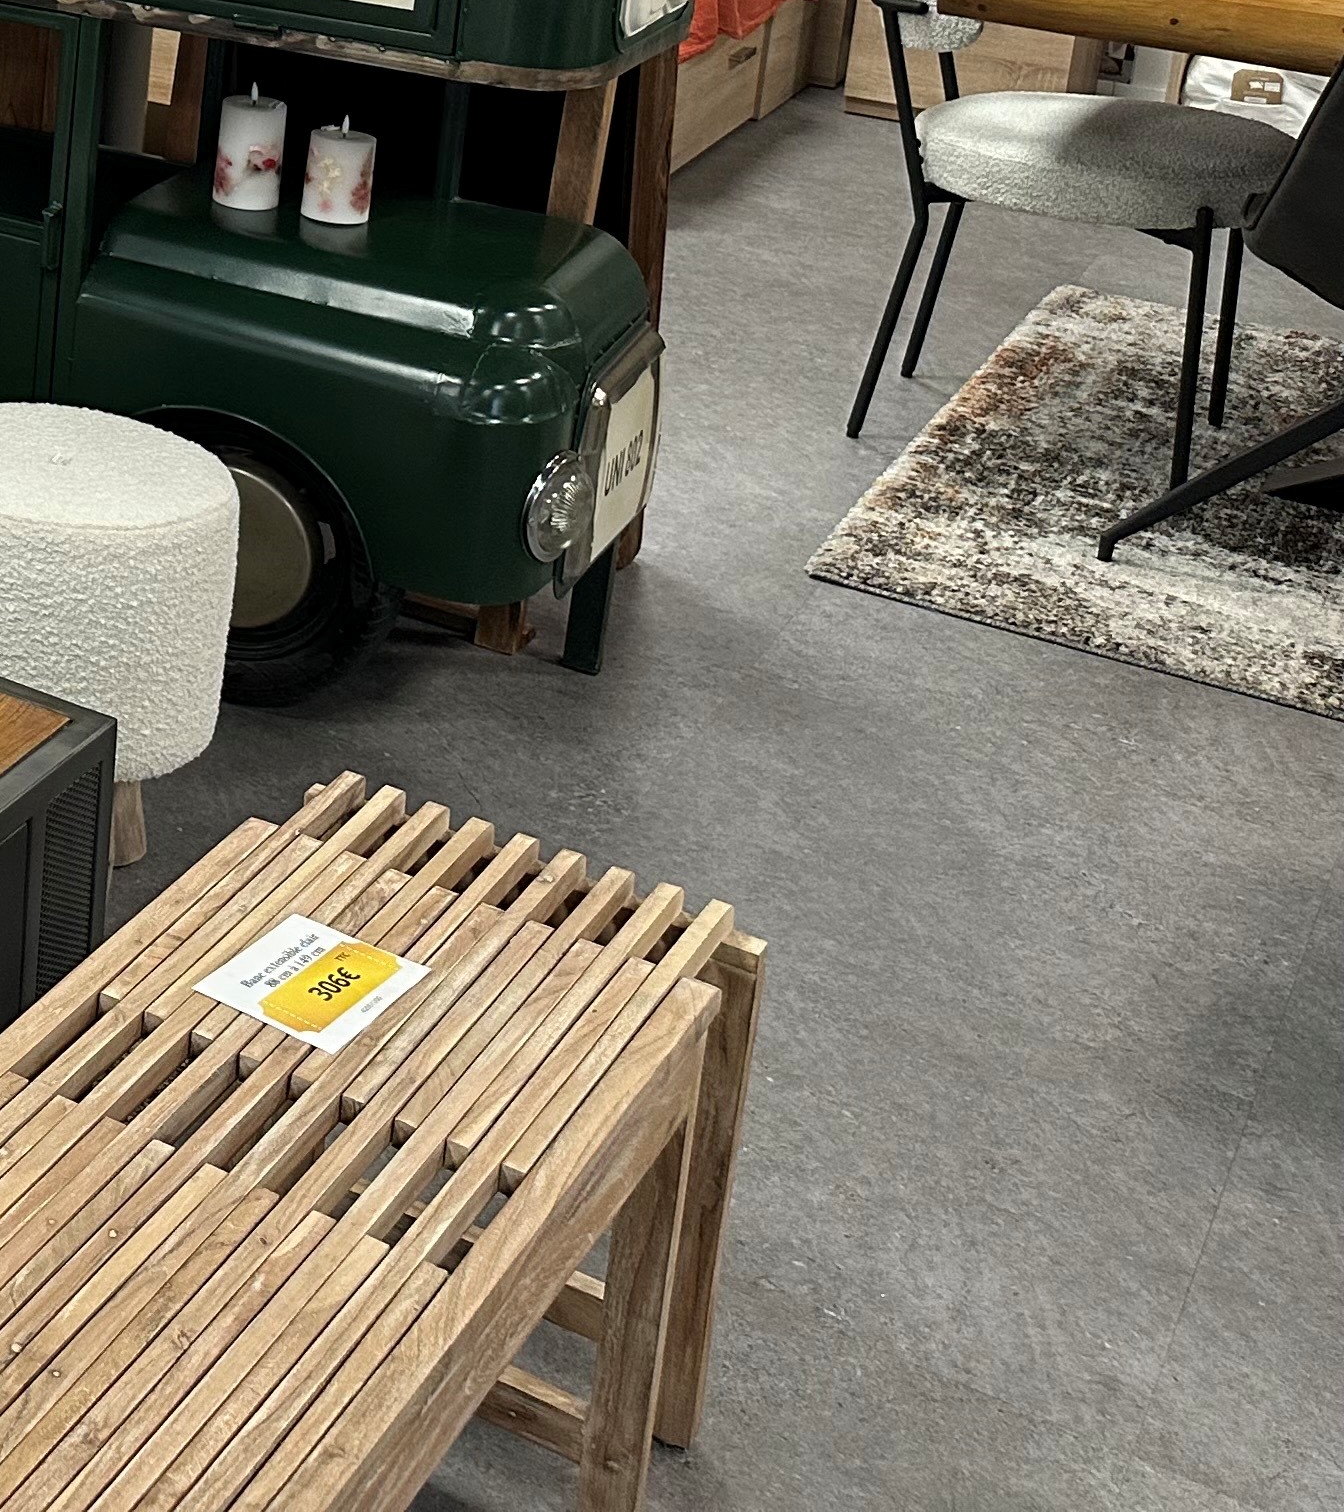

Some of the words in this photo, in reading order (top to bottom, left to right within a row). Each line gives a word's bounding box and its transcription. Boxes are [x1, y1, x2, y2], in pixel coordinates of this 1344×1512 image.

[240, 971, 265, 988] Banc
[264, 946, 303, 976] extensible
[300, 933, 320, 949] clair
[290, 963, 299, 972] à
[310, 946, 326, 956] cm
[334, 951, 351, 961] TTC
[308, 966, 361, 1002] 306€
